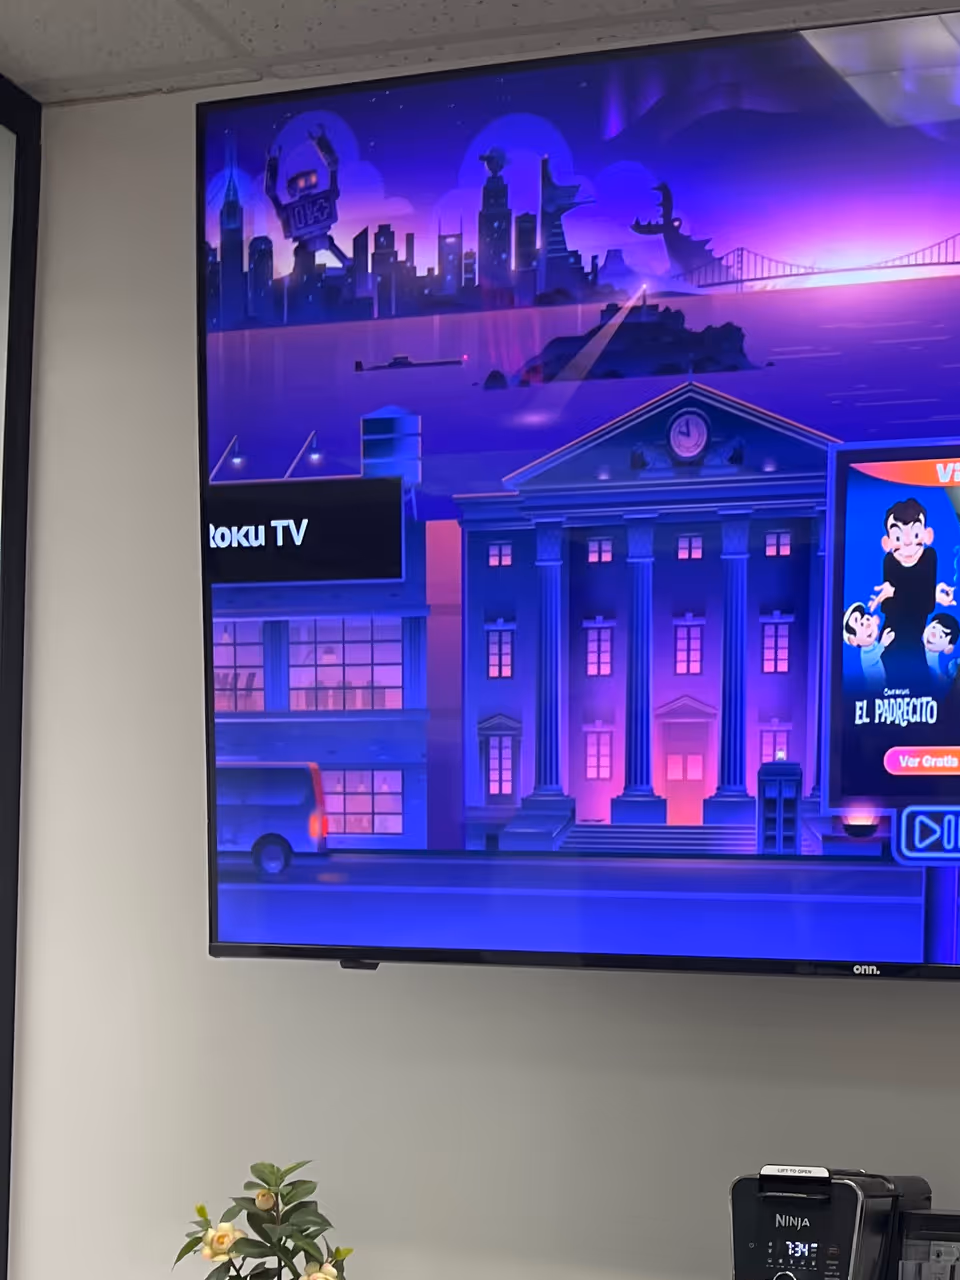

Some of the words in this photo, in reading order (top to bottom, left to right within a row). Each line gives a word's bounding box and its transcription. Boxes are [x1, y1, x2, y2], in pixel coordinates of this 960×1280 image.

[270, 518, 309, 547] TV
[854, 700, 870, 725] EL
[874, 696, 938, 728] PADRECITO
[899, 755, 919, 768] Ver
[922, 755, 959, 768] Gratis
[786, 1241, 809, 1257] 7:34
